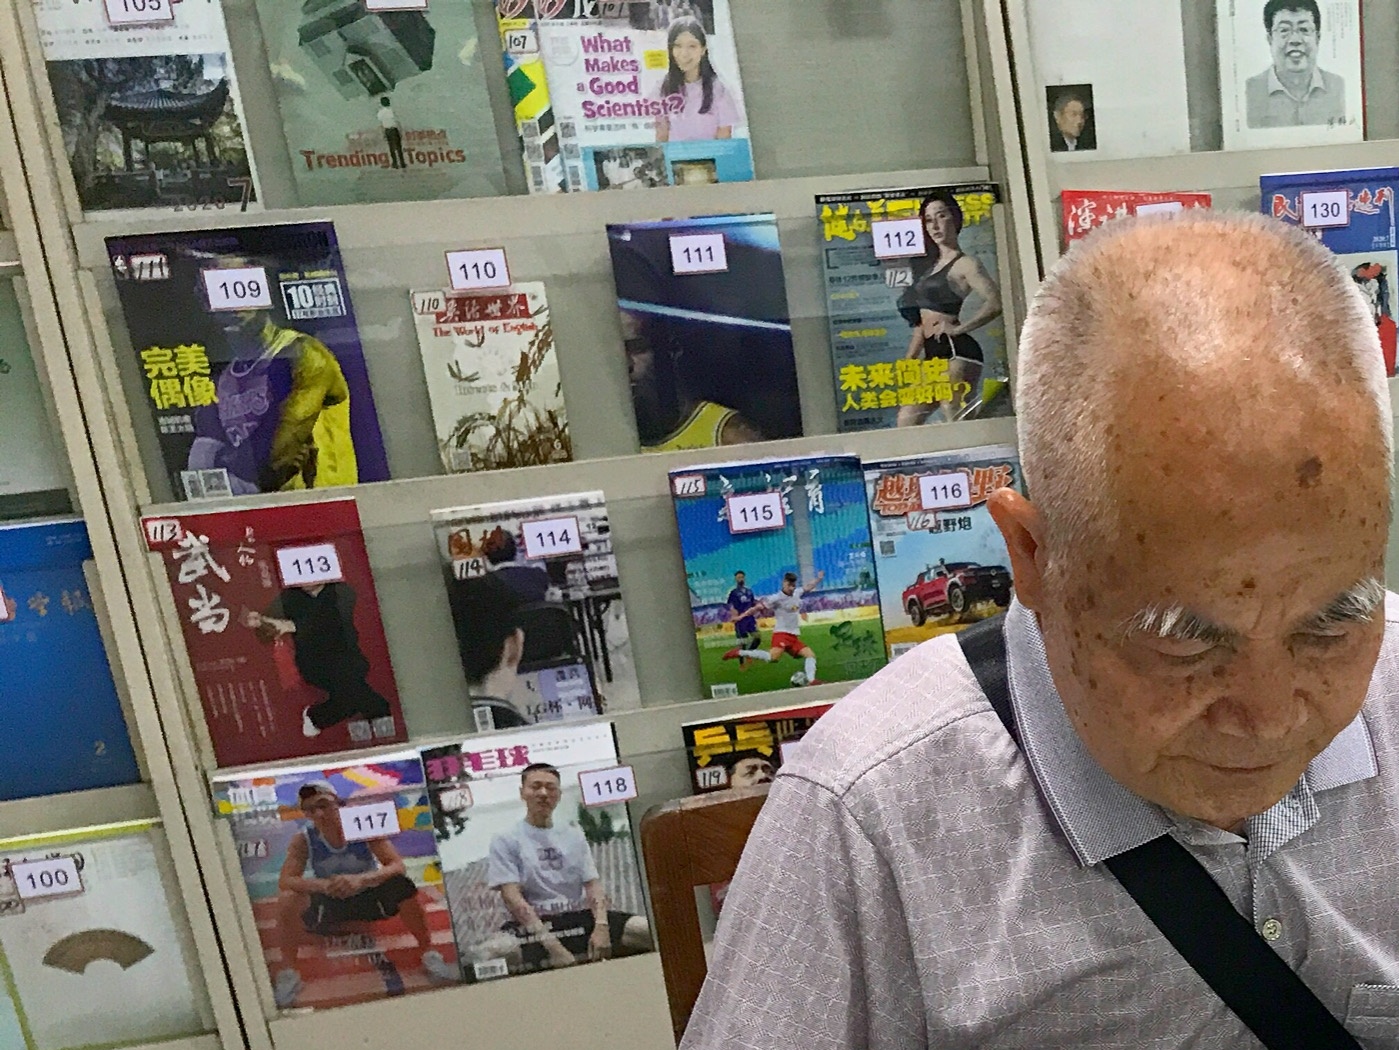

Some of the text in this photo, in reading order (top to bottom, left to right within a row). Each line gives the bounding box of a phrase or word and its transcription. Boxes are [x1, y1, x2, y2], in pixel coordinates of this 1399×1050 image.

[581, 33, 631, 53] What
[585, 58, 639, 73] Makes
[577, 76, 639, 95] a Good
[582, 96, 685, 119] Scientist?
[302, 147, 466, 171] Trending Topics
[1311, 202, 1340, 218] 130
[884, 230, 916, 248] 112
[683, 247, 715, 264] 111
[459, 262, 496, 281] 110
[220, 280, 261, 299] 109
[141, 344, 211, 378] 完美
[839, 357, 950, 392] 未来简史
[150, 376, 219, 409] 偶像
[931, 484, 962, 500] 116
[740, 505, 773, 523] 115
[536, 529, 571, 547] 114
[293, 556, 331, 576] 113
[173, 530, 231, 634] 武当
[593, 777, 627, 796] 118
[703, 769, 721, 788] 119
[353, 812, 388, 831] 117
[27, 869, 68, 889] 100
